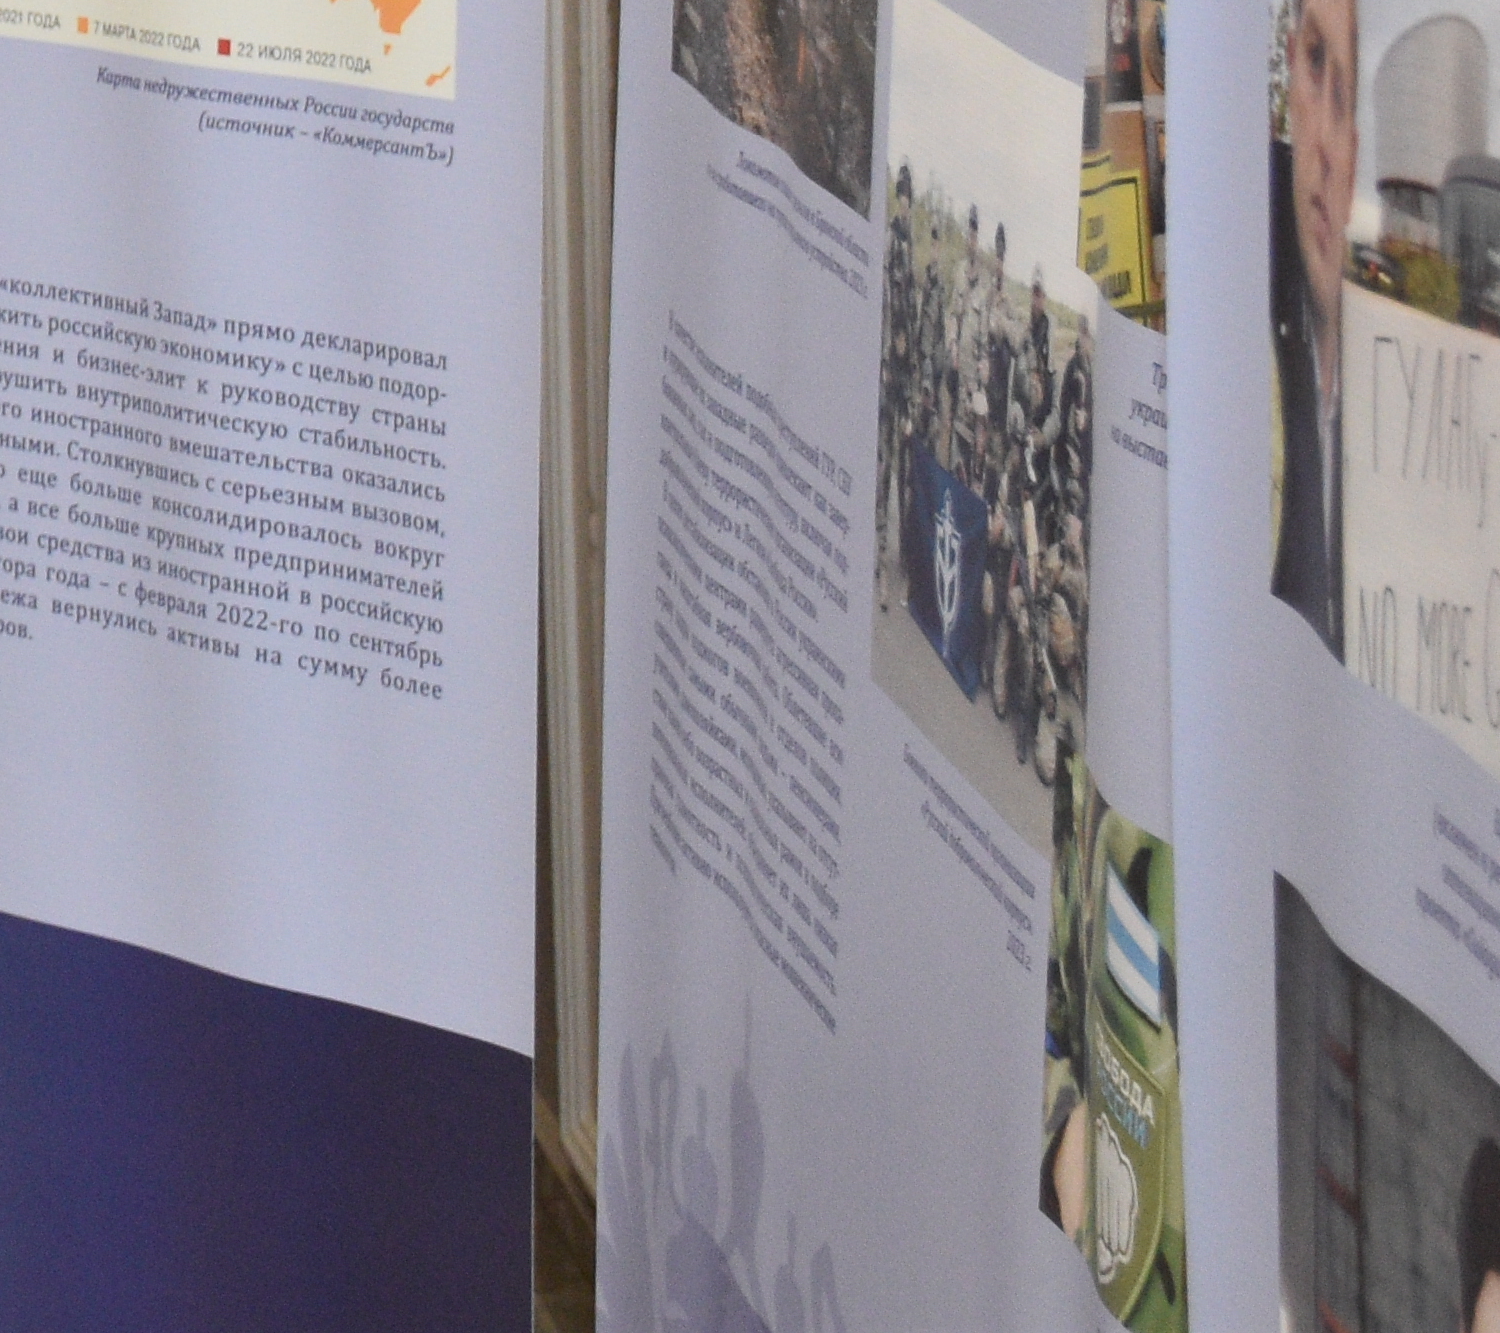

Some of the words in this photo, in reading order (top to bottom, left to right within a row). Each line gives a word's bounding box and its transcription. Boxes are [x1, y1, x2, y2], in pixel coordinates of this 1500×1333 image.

[26, 10, 62, 32] ГОДА
[94, 20, 100, 34] 7
[102, 21, 137, 41] МАРТА
[139, 28, 165, 47] 2022
[167, 32, 202, 54] ГОДА
[236, 40, 255, 60] 22
[257, 43, 303, 63] ИЮЛЯ
[305, 48, 337, 70] 2022
[339, 53, 373, 76] ГОДА
[96, 65, 142, 92] Карта
[143, 76, 301, 113] недружественных
[303, 94, 359, 122] России
[360, 107, 456, 137] государств
[197, 109, 296, 141] (источник
[312, 125, 455, 169] «КоммерсантЪ»)
[153, 299, 218, 335] Запад»
[223, 318, 296, 345] прямо
[299, 329, 448, 373] декларировал
